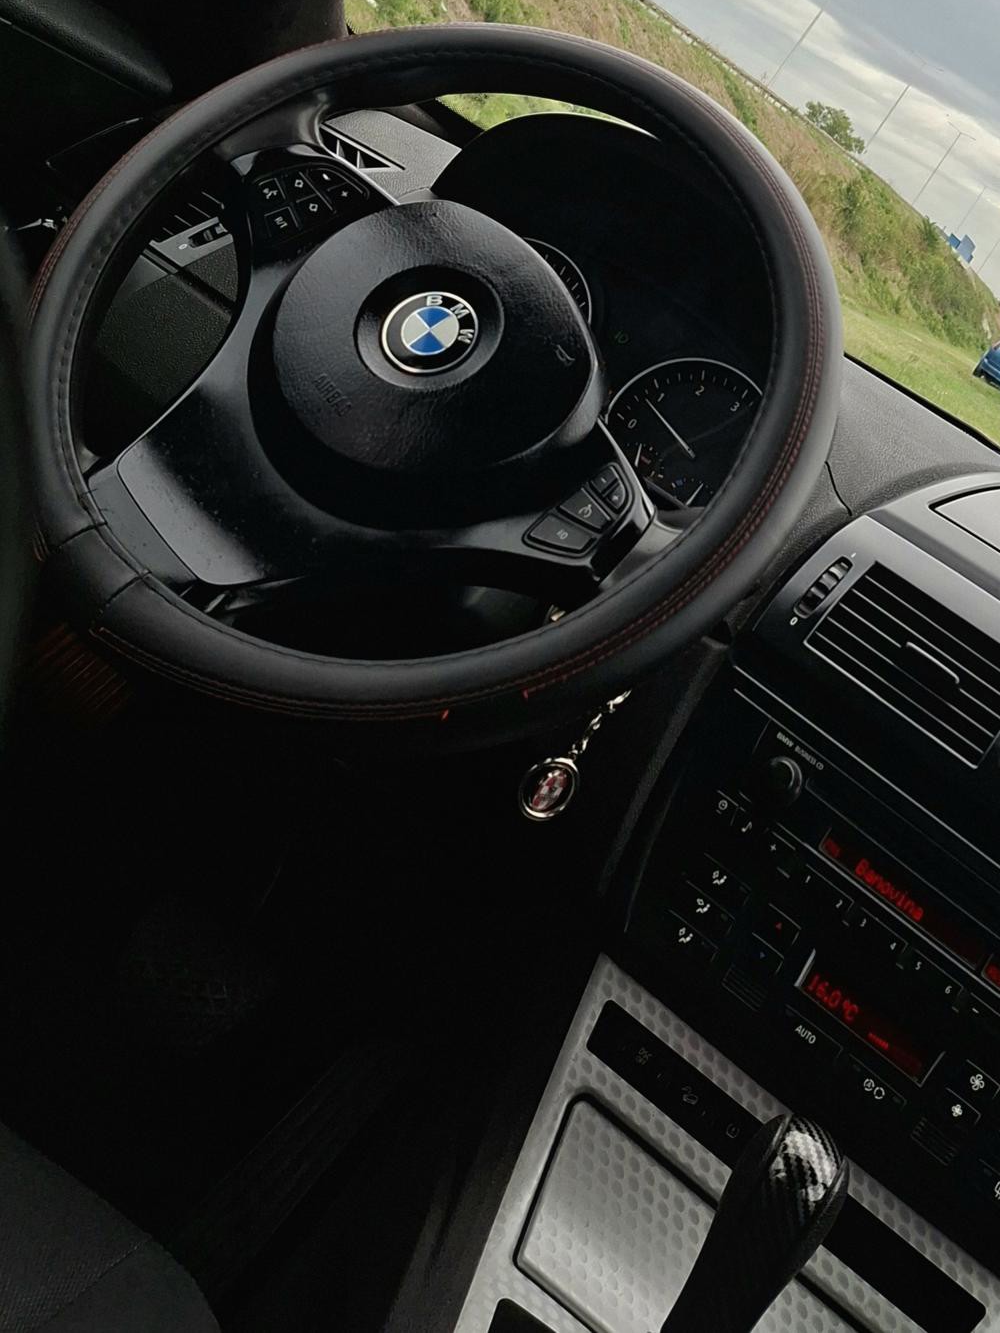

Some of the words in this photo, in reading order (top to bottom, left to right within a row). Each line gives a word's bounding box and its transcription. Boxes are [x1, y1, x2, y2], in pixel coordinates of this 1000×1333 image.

[426, 295, 476, 345] BMW
[312, 374, 352, 418] AIRBAG
[695, 386, 704, 396] 2
[657, 392, 665, 403] 1
[730, 401, 740, 412] 3
[627, 418, 637, 429] 0
[794, 1024, 818, 1045] AUTO
